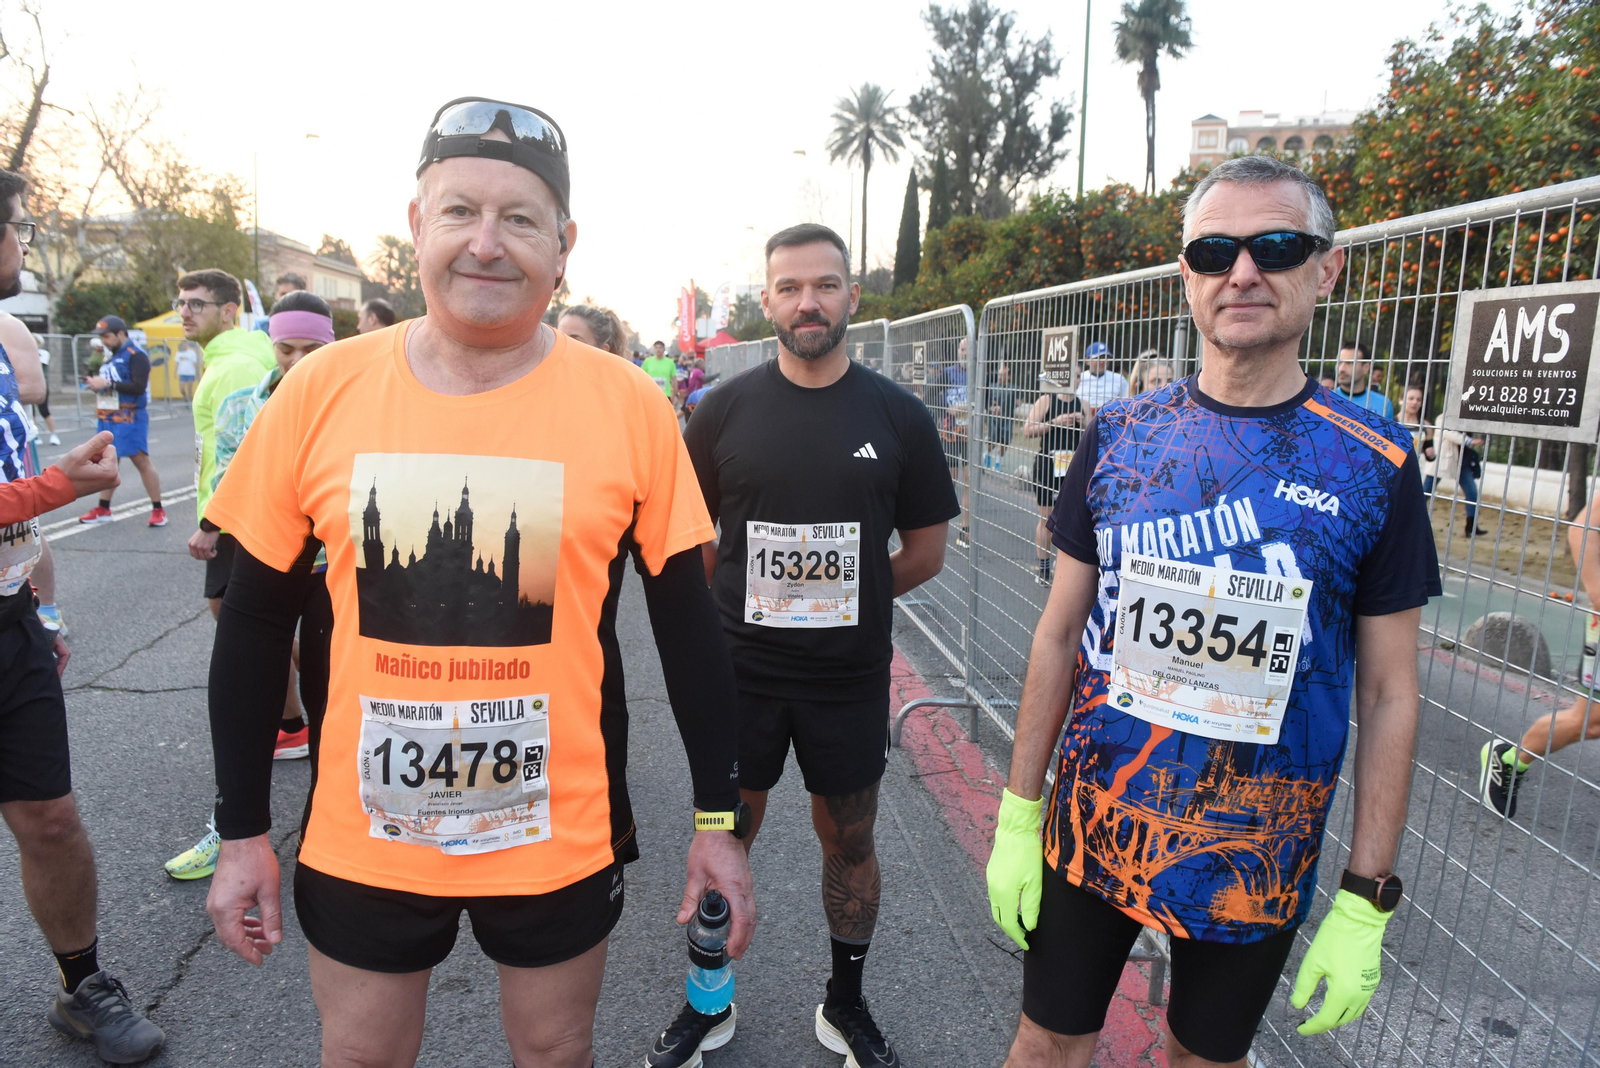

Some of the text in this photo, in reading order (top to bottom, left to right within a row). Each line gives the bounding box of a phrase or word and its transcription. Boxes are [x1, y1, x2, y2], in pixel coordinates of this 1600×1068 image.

[1484, 303, 1576, 363] AMS
[1047, 336, 1068, 362] AMS
[1472, 369, 1577, 378] SOLUCIONES EN EVENTOS
[1479, 385, 1576, 406] 91 828 91 73
[1469, 404, 1569, 418] www.alquiler-ms.com
[1326, 413, 1390, 451] 28ENERO24
[1274, 479, 1339, 516] HOKA
[770, 526, 796, 537] MARATÓN
[813, 525, 844, 539] SEVILLA
[1121, 495, 1261, 559] MARATÓN
[756, 548, 840, 580] 15328
[1130, 558, 1283, 602] MEDIO MARATÓN SEVILLA
[1128, 597, 1267, 667] 13354
[375, 652, 530, 682] Mañico jubilado
[1168, 666, 1185, 674] MANUEL
[1172, 656, 1203, 669] Manuel
[1152, 670, 1187, 684] DELGADO
[1189, 679, 1220, 690] LANZAS
[370, 699, 525, 724] MEDIO MARATÓN SEVILLA
[1172, 710, 1199, 725] HOKA
[373, 737, 518, 789] 13478
[428, 791, 462, 799] JAVIER
